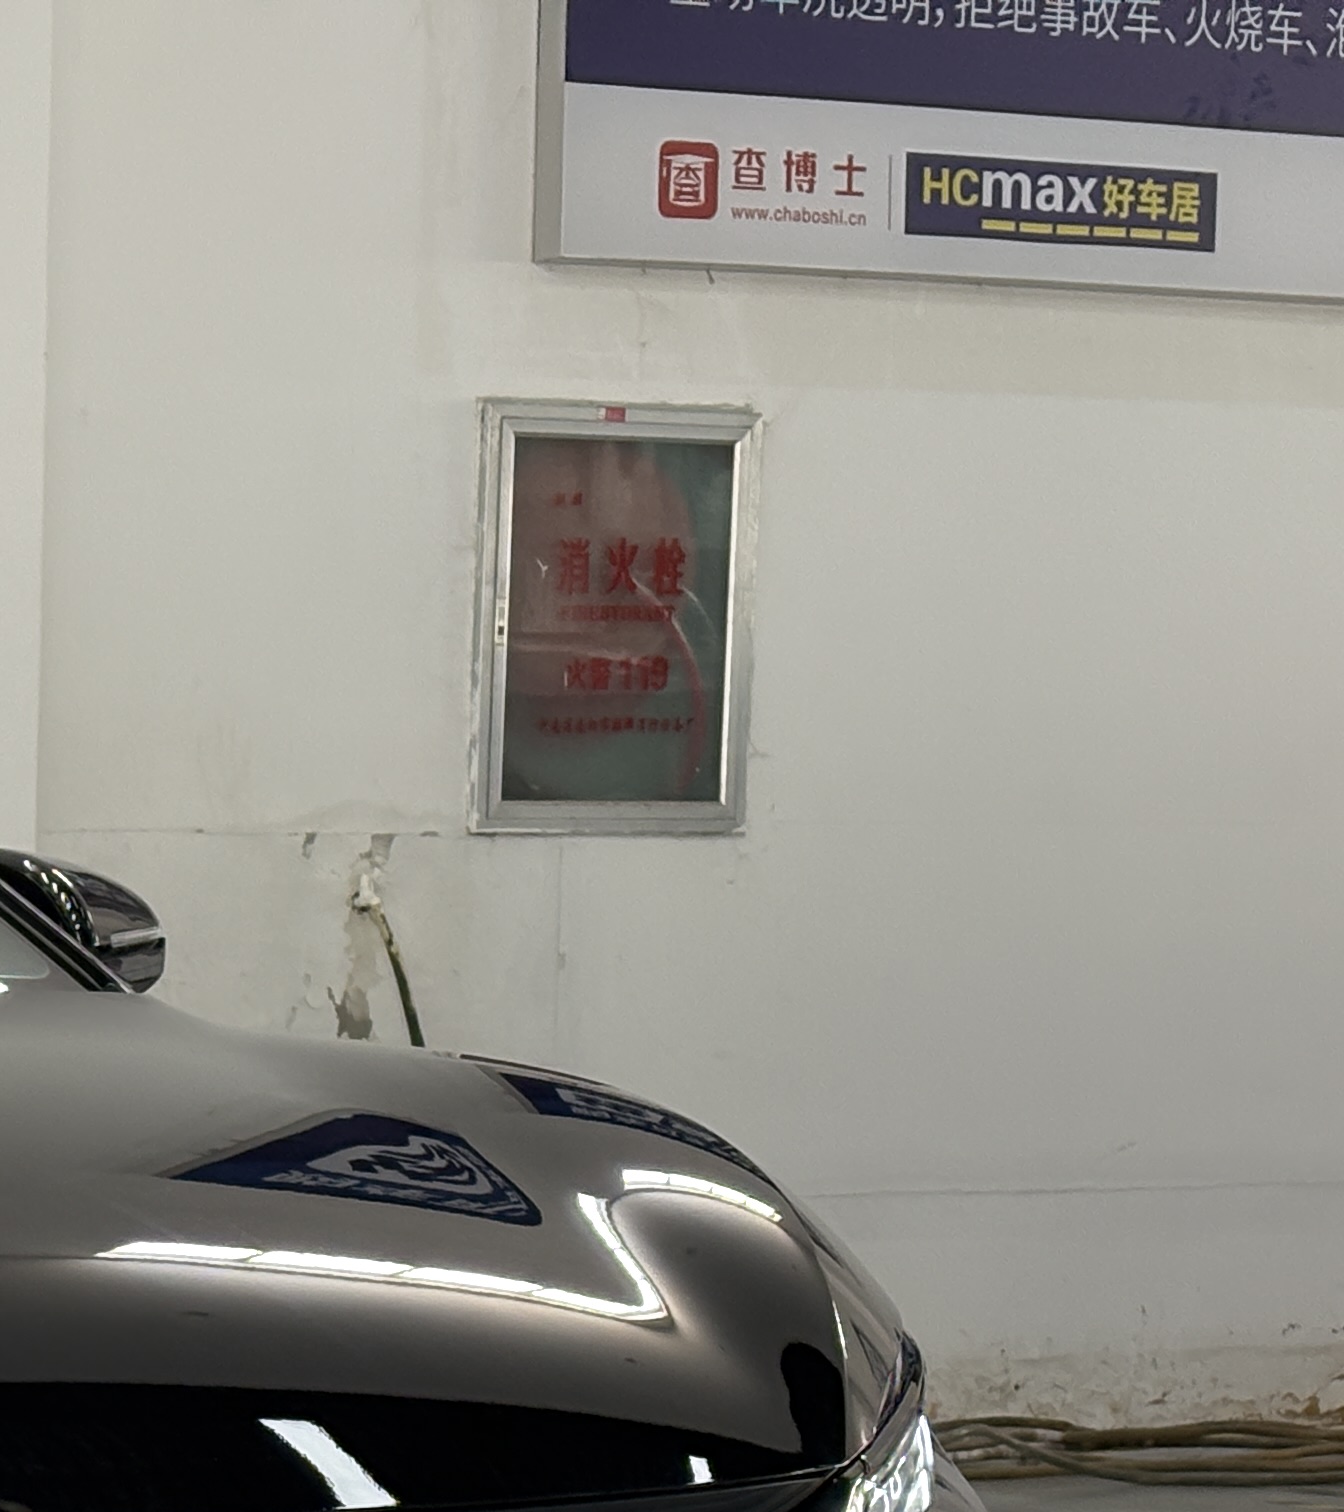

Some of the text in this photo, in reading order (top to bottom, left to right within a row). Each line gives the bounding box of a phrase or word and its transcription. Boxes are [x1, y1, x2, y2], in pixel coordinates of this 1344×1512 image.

[731, 147, 867, 197] 查博士
[922, 166, 1201, 224] HCmax 好车居
[730, 206, 867, 226] www.chaboshi.cn
[556, 537, 686, 595] 消火栓
